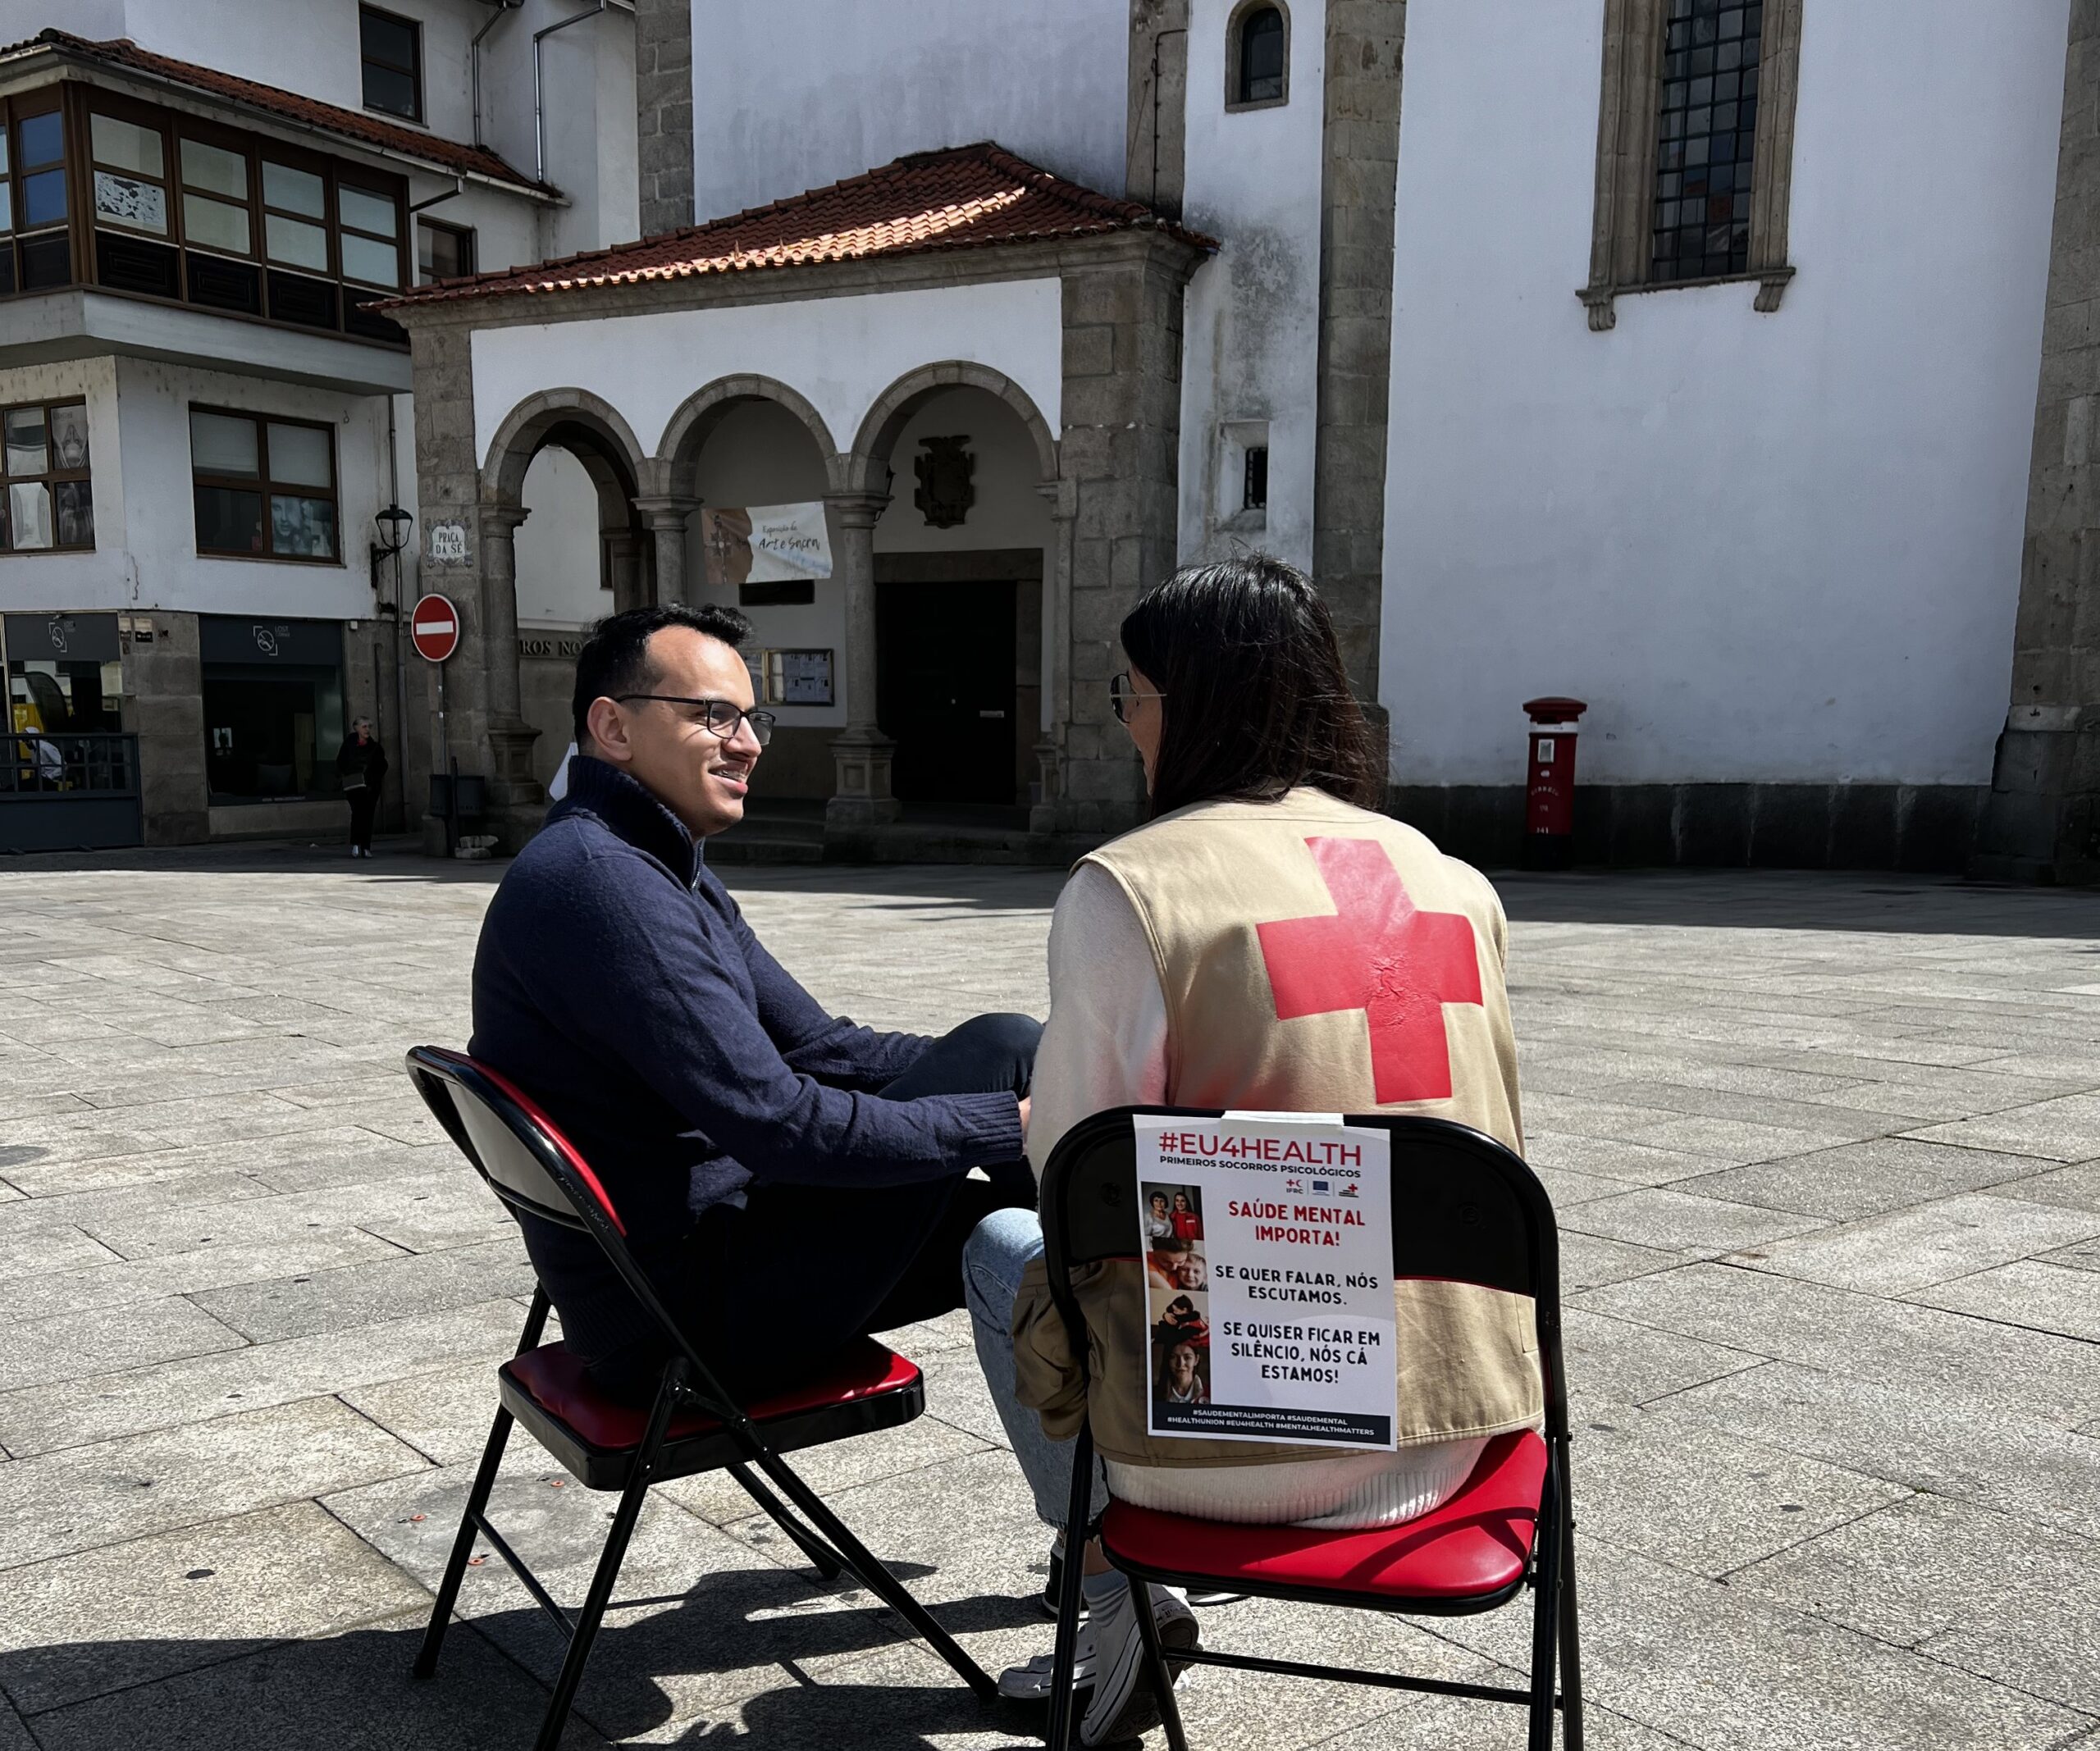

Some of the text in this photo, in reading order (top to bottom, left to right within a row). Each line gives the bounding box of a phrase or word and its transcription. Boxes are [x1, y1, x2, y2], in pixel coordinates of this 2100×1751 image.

[436, 541, 462, 554] DA SÉ
[759, 537, 821, 551] Arte Sacra
[1159, 1132, 1361, 1166] #EU4HEALTH
[1160, 1156, 1361, 1178] PRIMEIROS SOCORROS PSICOLÓGICOS
[1229, 1198, 1366, 1226] SAÚDE MENTAL
[1255, 1225, 1340, 1247] IMPORTA!
[1215, 1265, 1235, 1279] SE
[1239, 1267, 1281, 1283] QUER
[1346, 1272, 1379, 1289] NÓS
[1249, 1285, 1348, 1306] ESCUTAMOS.
[1223, 1321, 1381, 1346] SE QUISER FICAR EM
[1231, 1340, 1367, 1366] SILÊNCIO, NÓS CÁ
[1261, 1364, 1340, 1384] ESTAMOS!
[1167, 1416, 1375, 1436] #HEALTHUNION #EU4HEALTH #MENTALHEALTHMATTERS
[1193, 1409, 1348, 1425] #SAUDEMENTALIMPORTA #SAUDEMENTAL
